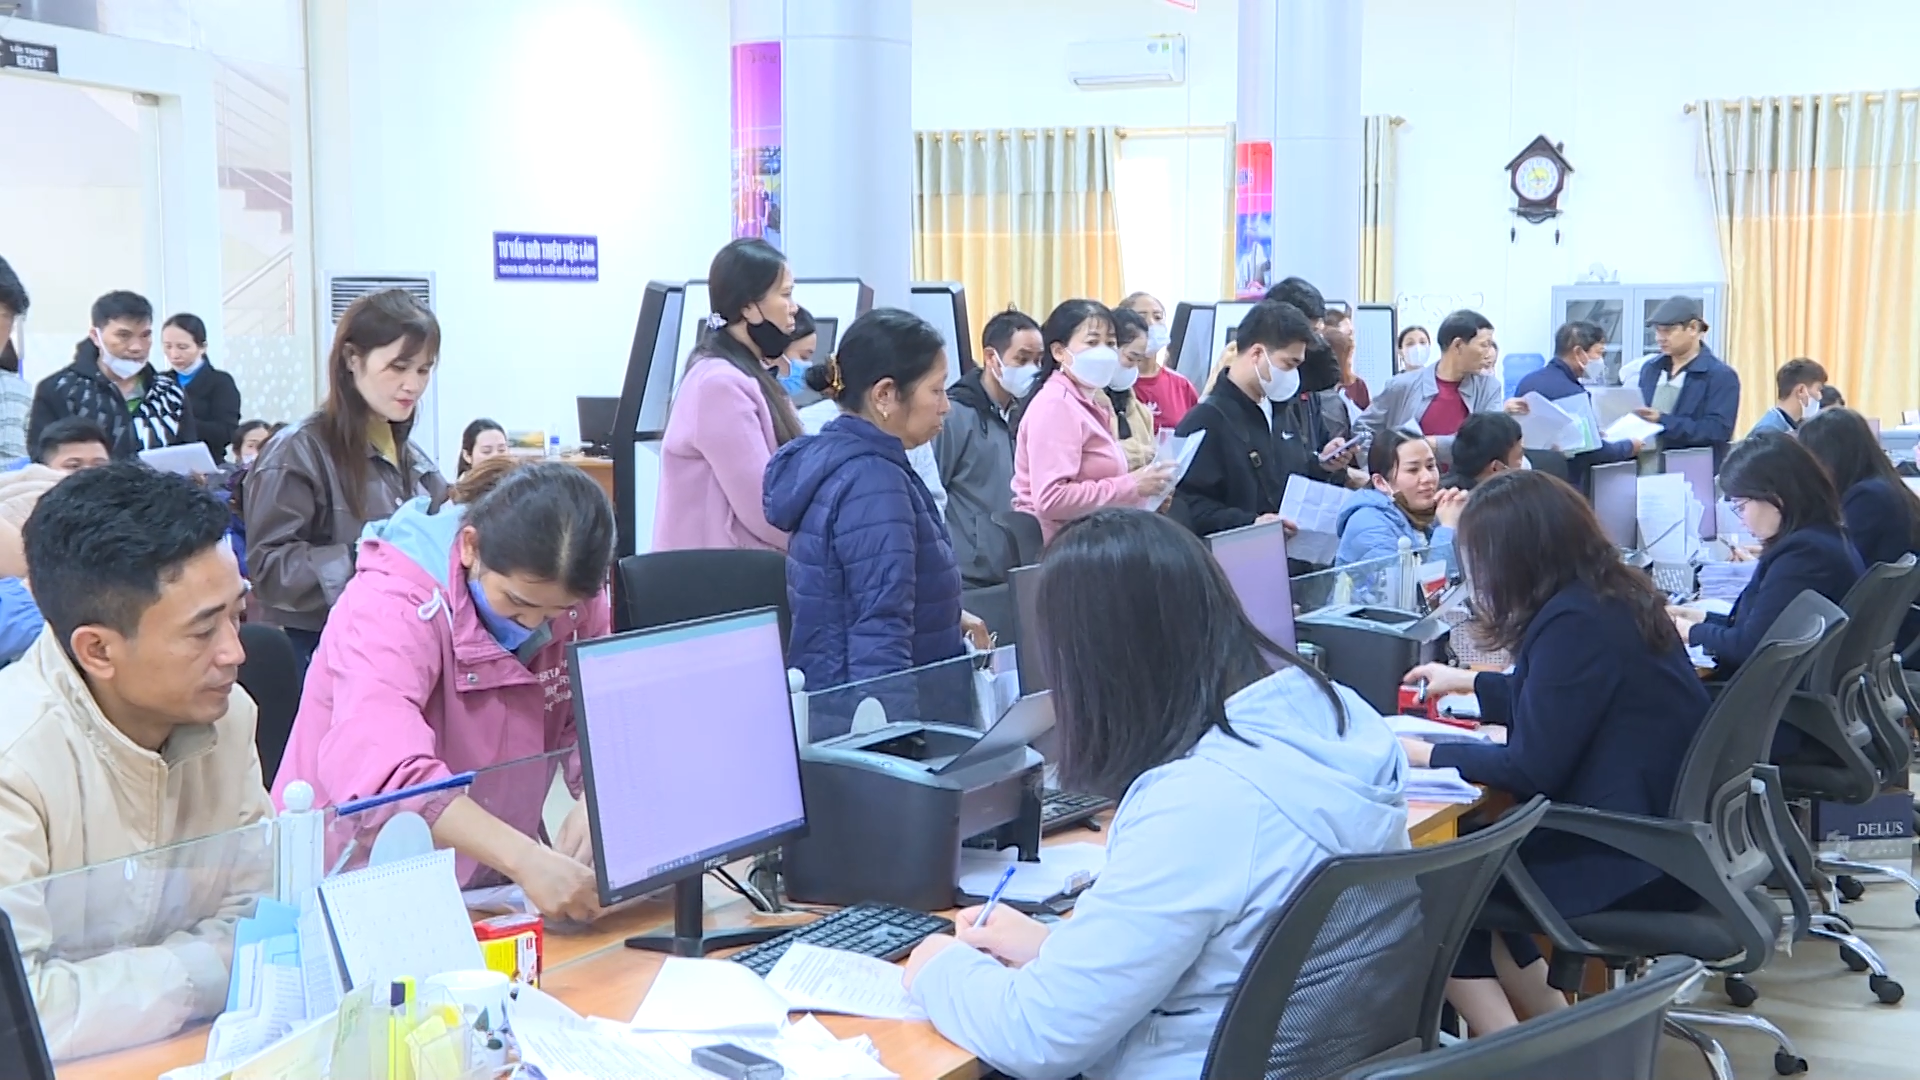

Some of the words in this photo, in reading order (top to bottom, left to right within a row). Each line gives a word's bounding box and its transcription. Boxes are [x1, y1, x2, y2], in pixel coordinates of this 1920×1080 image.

[16, 54, 45, 68] EXIT
[498, 240, 508, 259] TƯ
[509, 236, 524, 259] VẤN
[525, 239, 540, 260] GIỚI
[541, 239, 561, 263] THIỆU
[562, 240, 579, 264] VIỆC
[579, 239, 595, 261] LÀM
[1857, 821, 1904, 836] DELUS
